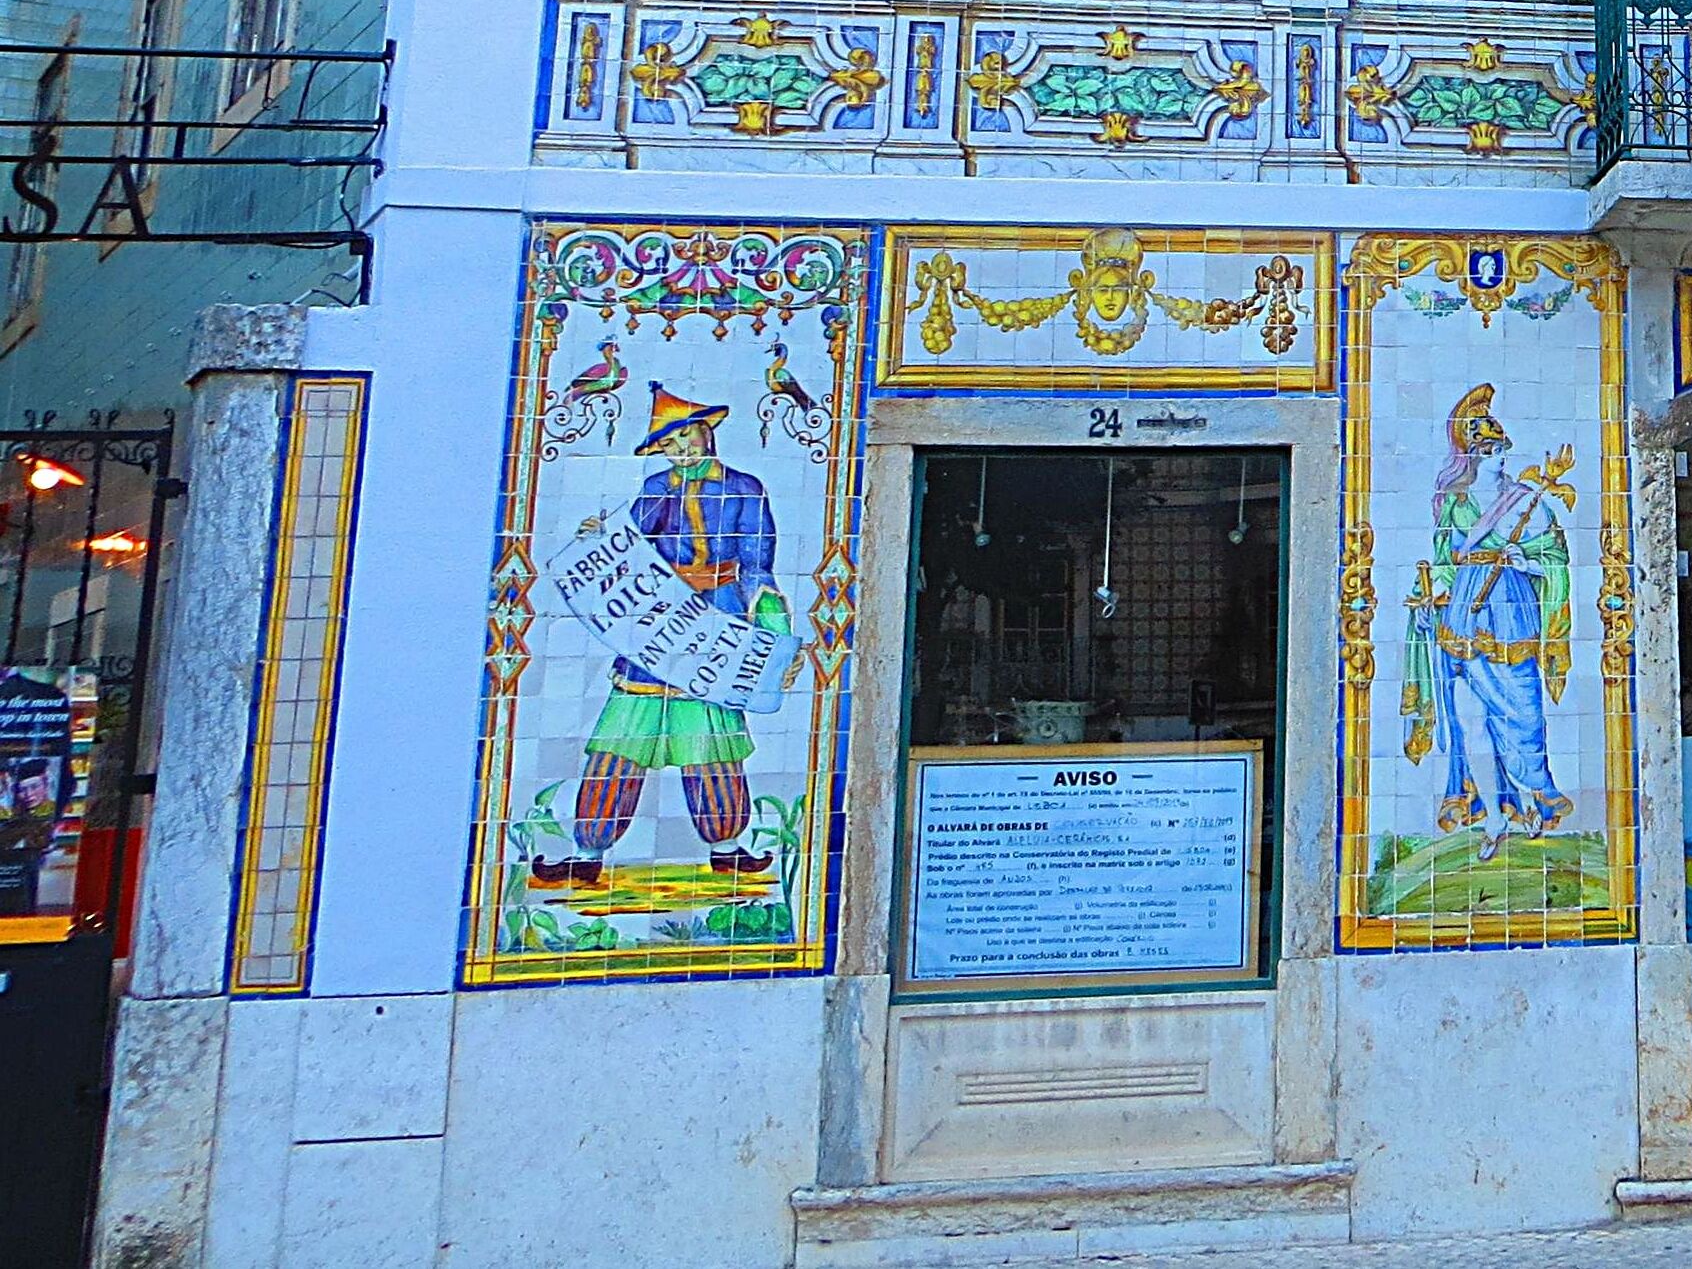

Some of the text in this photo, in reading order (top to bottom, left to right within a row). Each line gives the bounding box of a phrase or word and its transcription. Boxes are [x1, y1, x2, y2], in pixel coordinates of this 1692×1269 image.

[1089, 407, 1123, 438] 24
[556, 524, 641, 601] FABRICA
[600, 560, 630, 595] DE
[590, 562, 673, 633] LOIÇA
[636, 601, 672, 627] DE
[638, 592, 709, 669] ANTONIO
[689, 621, 749, 698] COSTA
[724, 629, 777, 710] LAMEGO
[1053, 771, 1118, 787] AVISO
[927, 824, 935, 832] O
[937, 820, 978, 832] ALVARÁ
[980, 822, 994, 832] DE
[996, 822, 1032, 832] OBRAS
[1034, 821, 1049, 831] DE
[927, 839, 956, 847] Titular
[958, 839, 970, 847] do
[972, 838, 1000, 846] Alvará
[928, 852, 957, 860] Prédio
[960, 851, 996, 859] descrito
[999, 851, 1010, 859] na
[1012, 850, 1075, 859] Conservatória
[1091, 849, 1125, 858] Registo
[1128, 848, 1158, 856] Predial
[927, 864, 945, 872] Sob
[1049, 861, 1082, 869] inscrito
[1098, 859, 1125, 867] matriz
[1128, 859, 1144, 867] sob
[1155, 859, 1180, 868] artigo
[941, 877, 980, 886] freguesia
[940, 891, 963, 899] obras
[992, 890, 1036, 899] aprovadas
[1039, 889, 1052, 898] por
[1139, 900, 1177, 908] edificação
[1080, 913, 1100, 921] obras
[950, 953, 978, 962] Prazo
[981, 954, 1004, 963] para
[1006, 953, 1013, 961] a
[1016, 950, 1067, 960] conclusão
[1070, 950, 1088, 958] das
[1091, 949, 1119, 958] obras
